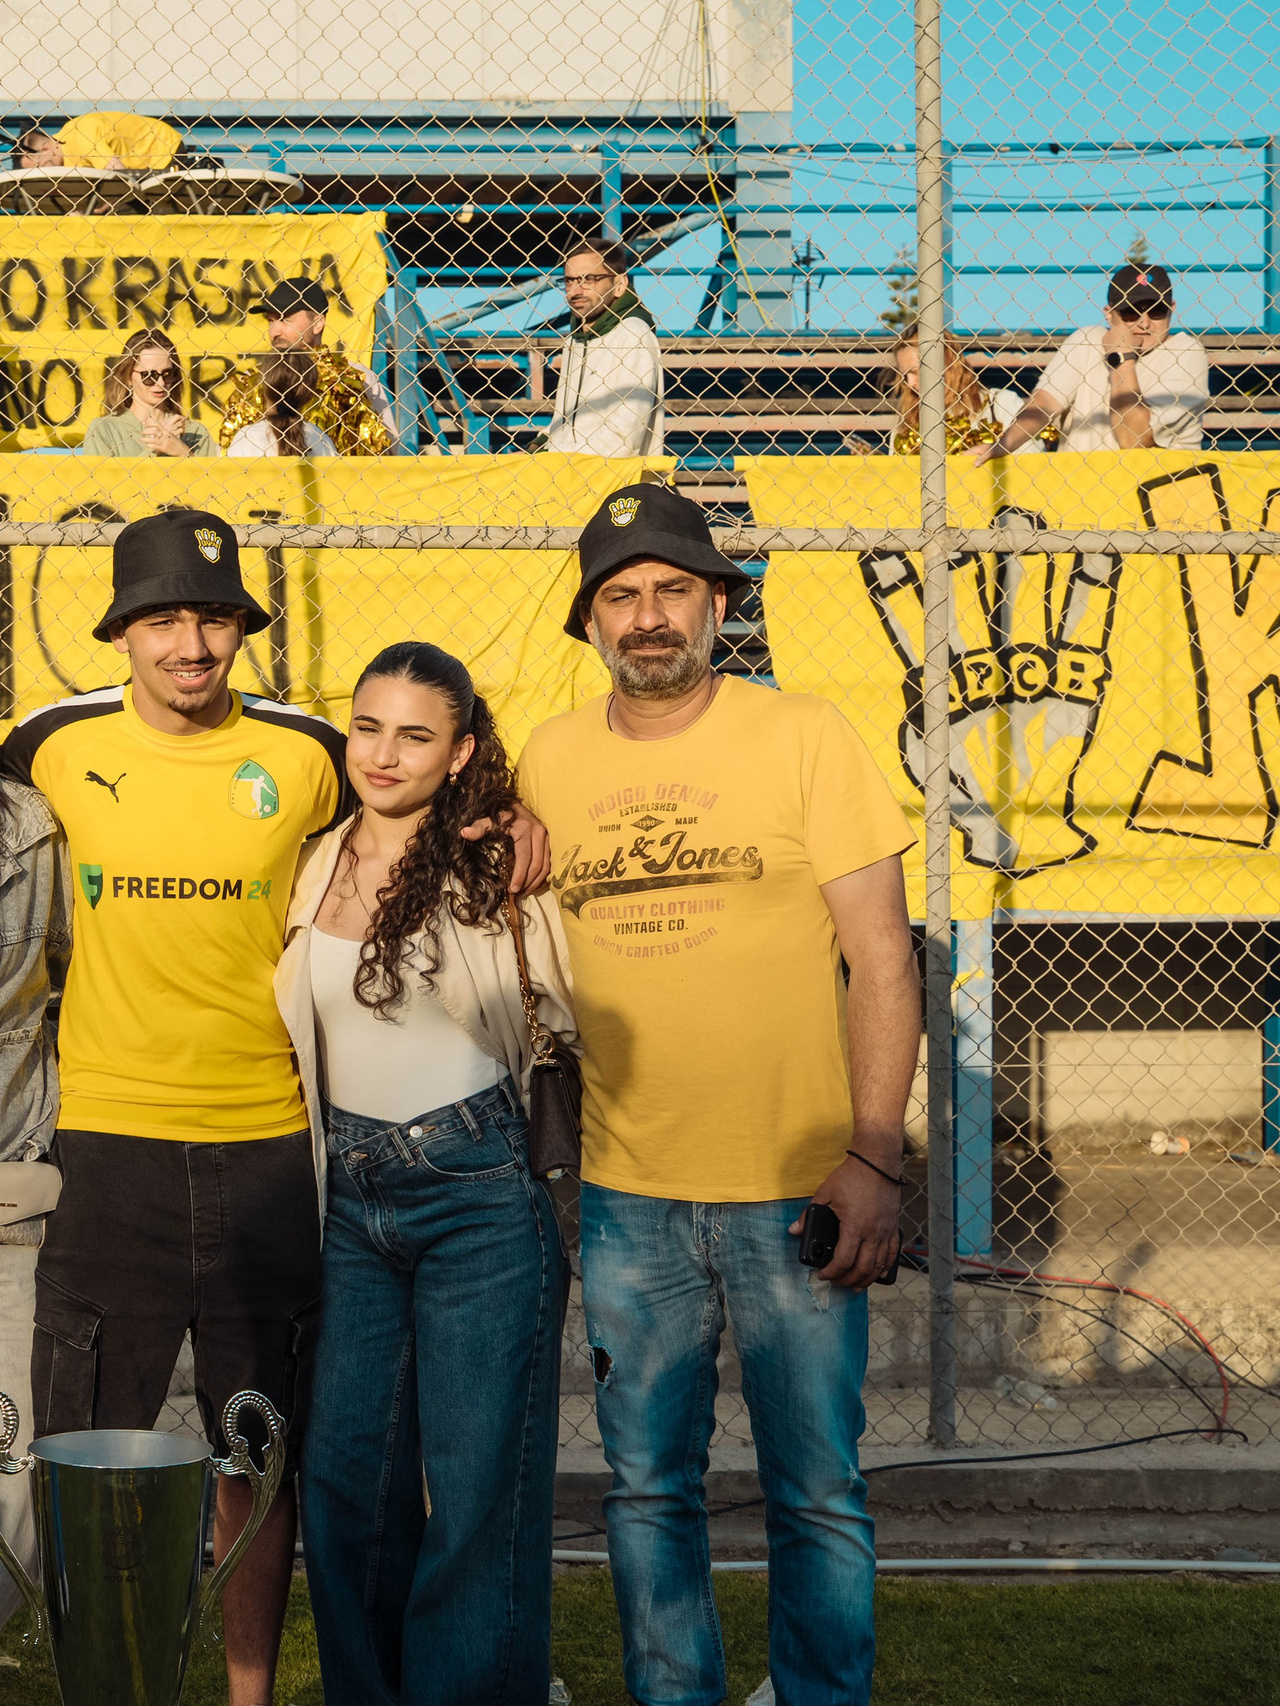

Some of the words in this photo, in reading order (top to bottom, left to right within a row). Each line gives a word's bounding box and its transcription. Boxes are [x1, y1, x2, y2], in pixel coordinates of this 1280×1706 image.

[587, 785, 646, 822] INDIGO
[654, 783, 719, 811] DENIM
[619, 802, 678, 818] ESTABLISHED
[598, 823, 621, 833] UNION
[675, 816, 699, 826] MADE
[628, 835, 656, 860] &
[641, 831, 761, 875] Jones
[552, 844, 627, 890] Jack
[112, 876, 243, 901] FREEDOM
[247, 878, 273, 900] 24
[589, 904, 646, 921] QUALITY
[649, 898, 725, 917] CLOTHING
[614, 920, 663, 936] VINTAGE
[668, 918, 689, 932] CO.
[593, 934, 623, 956] UNION
[625, 940, 680, 959] CRAFTED
